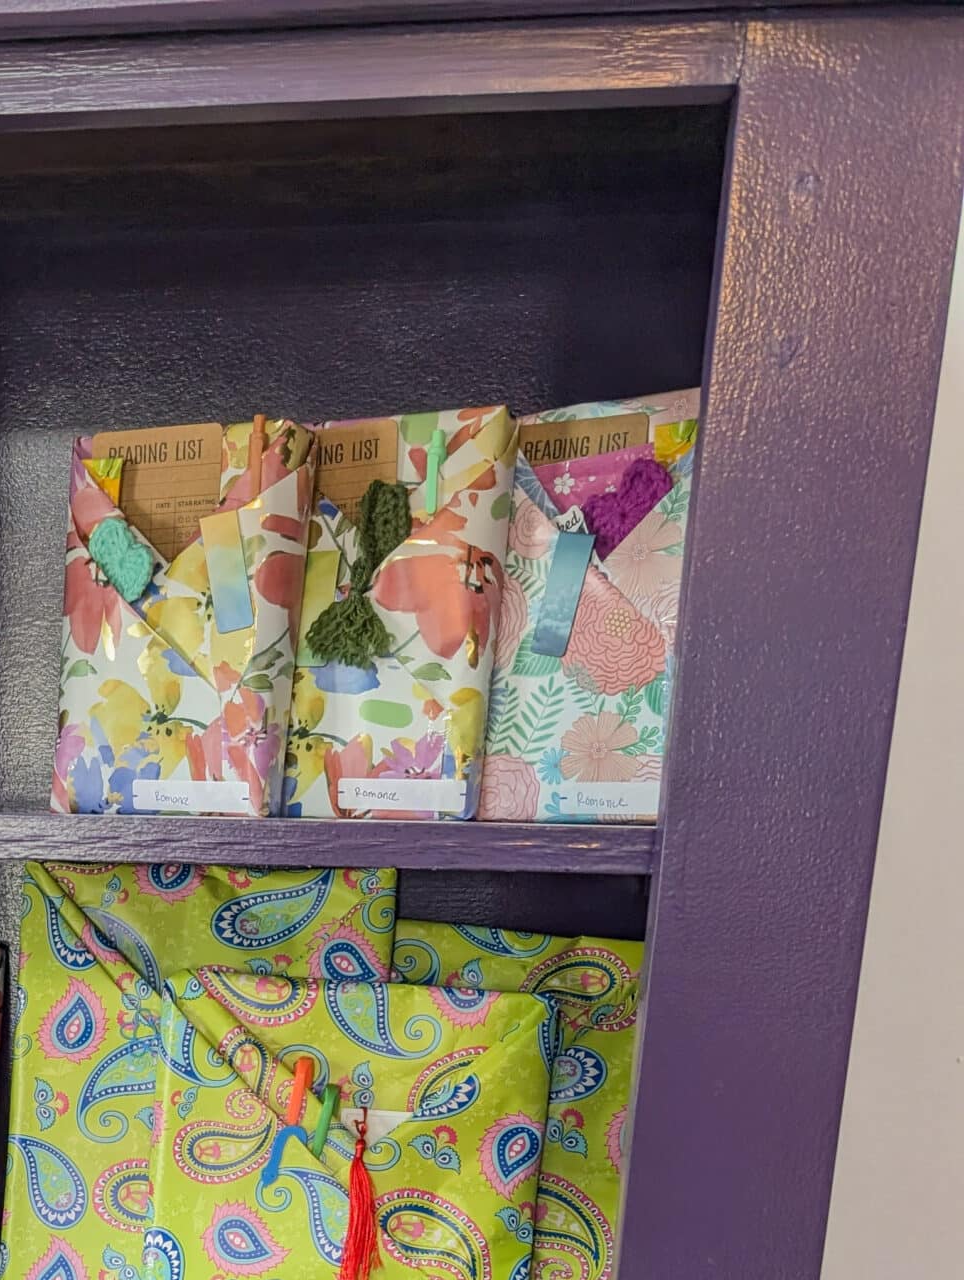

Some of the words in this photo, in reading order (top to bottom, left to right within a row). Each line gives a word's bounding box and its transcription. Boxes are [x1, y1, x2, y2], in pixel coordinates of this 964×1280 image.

[175, 438, 204, 461] LIST
[352, 438, 380, 462] LIST
[354, 786, 399, 801] Romance
[576, 791, 629, 809] Romance
